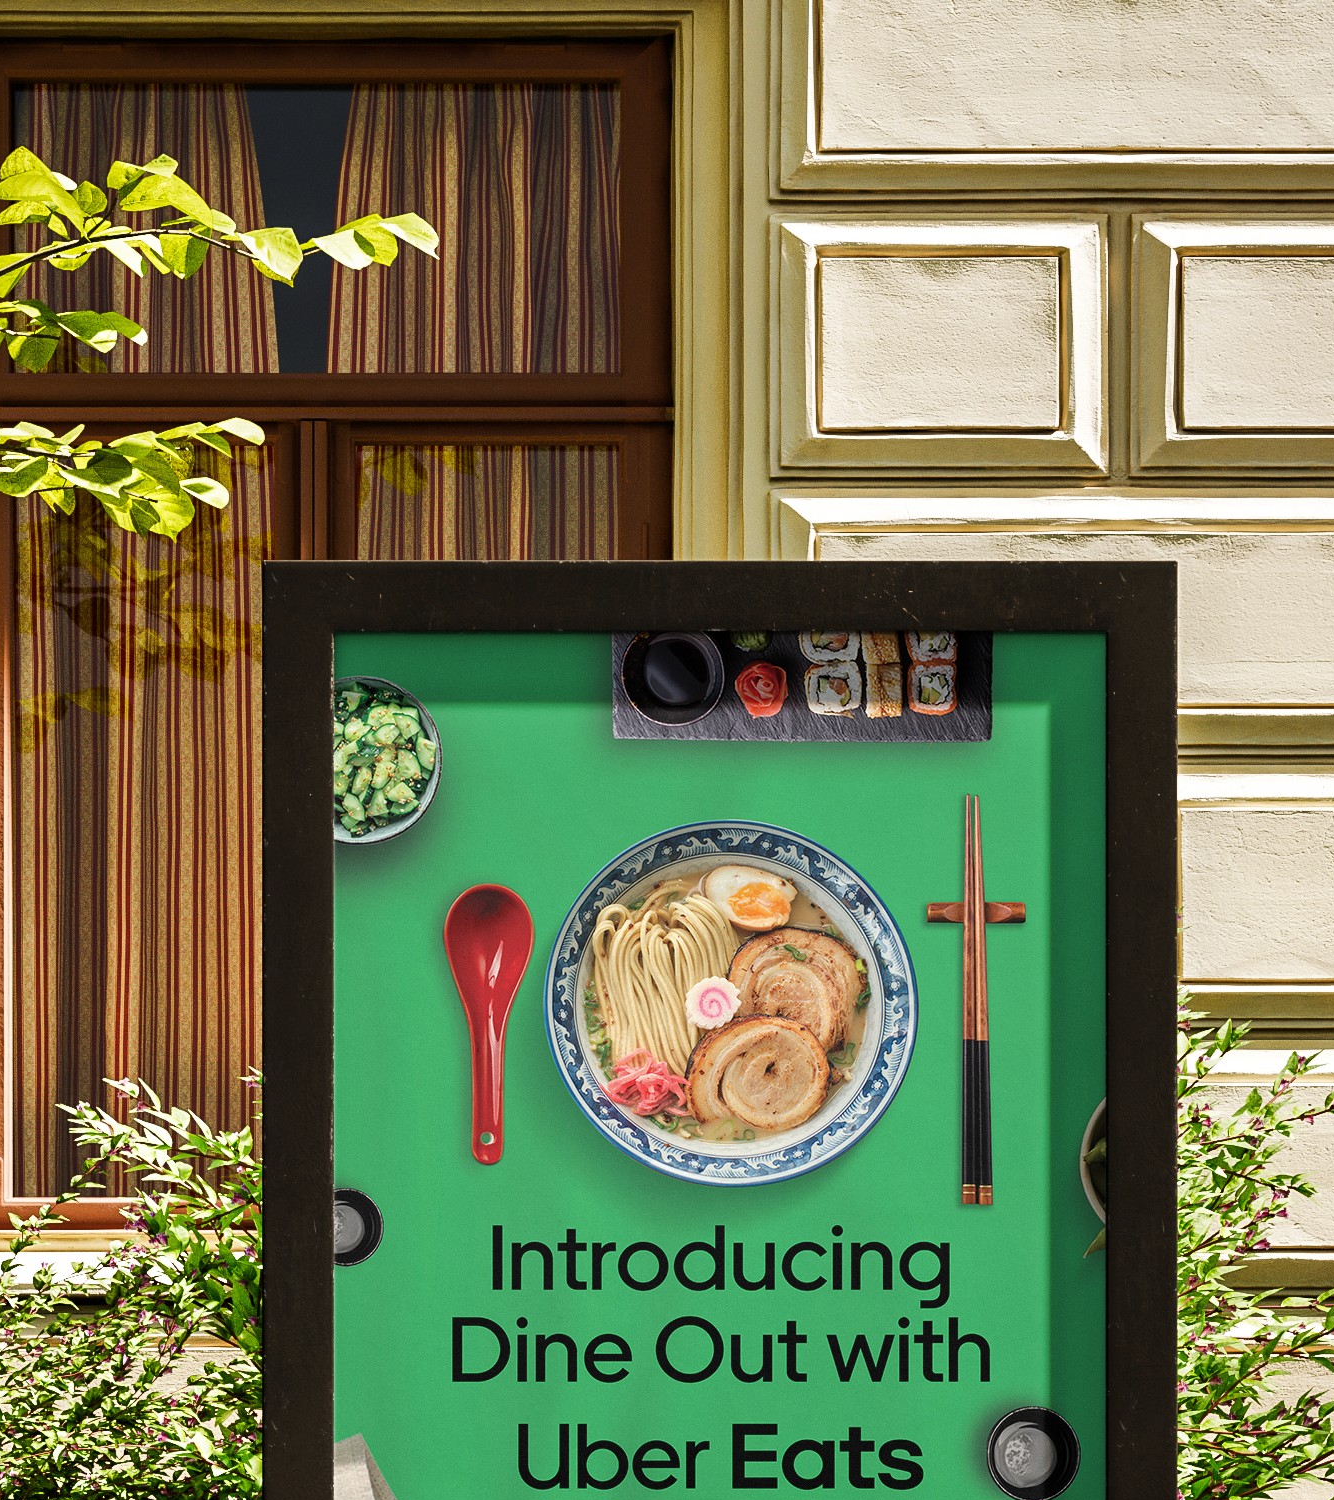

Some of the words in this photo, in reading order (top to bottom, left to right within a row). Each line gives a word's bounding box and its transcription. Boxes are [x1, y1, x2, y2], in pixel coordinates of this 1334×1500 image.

[492, 1224, 950, 1309] Introducing
[451, 1316, 633, 1384] Dine
[655, 1315, 808, 1384] Out
[826, 1316, 991, 1383] with
[517, 1423, 710, 1491] Uber
[731, 1423, 924, 1491] Eats
